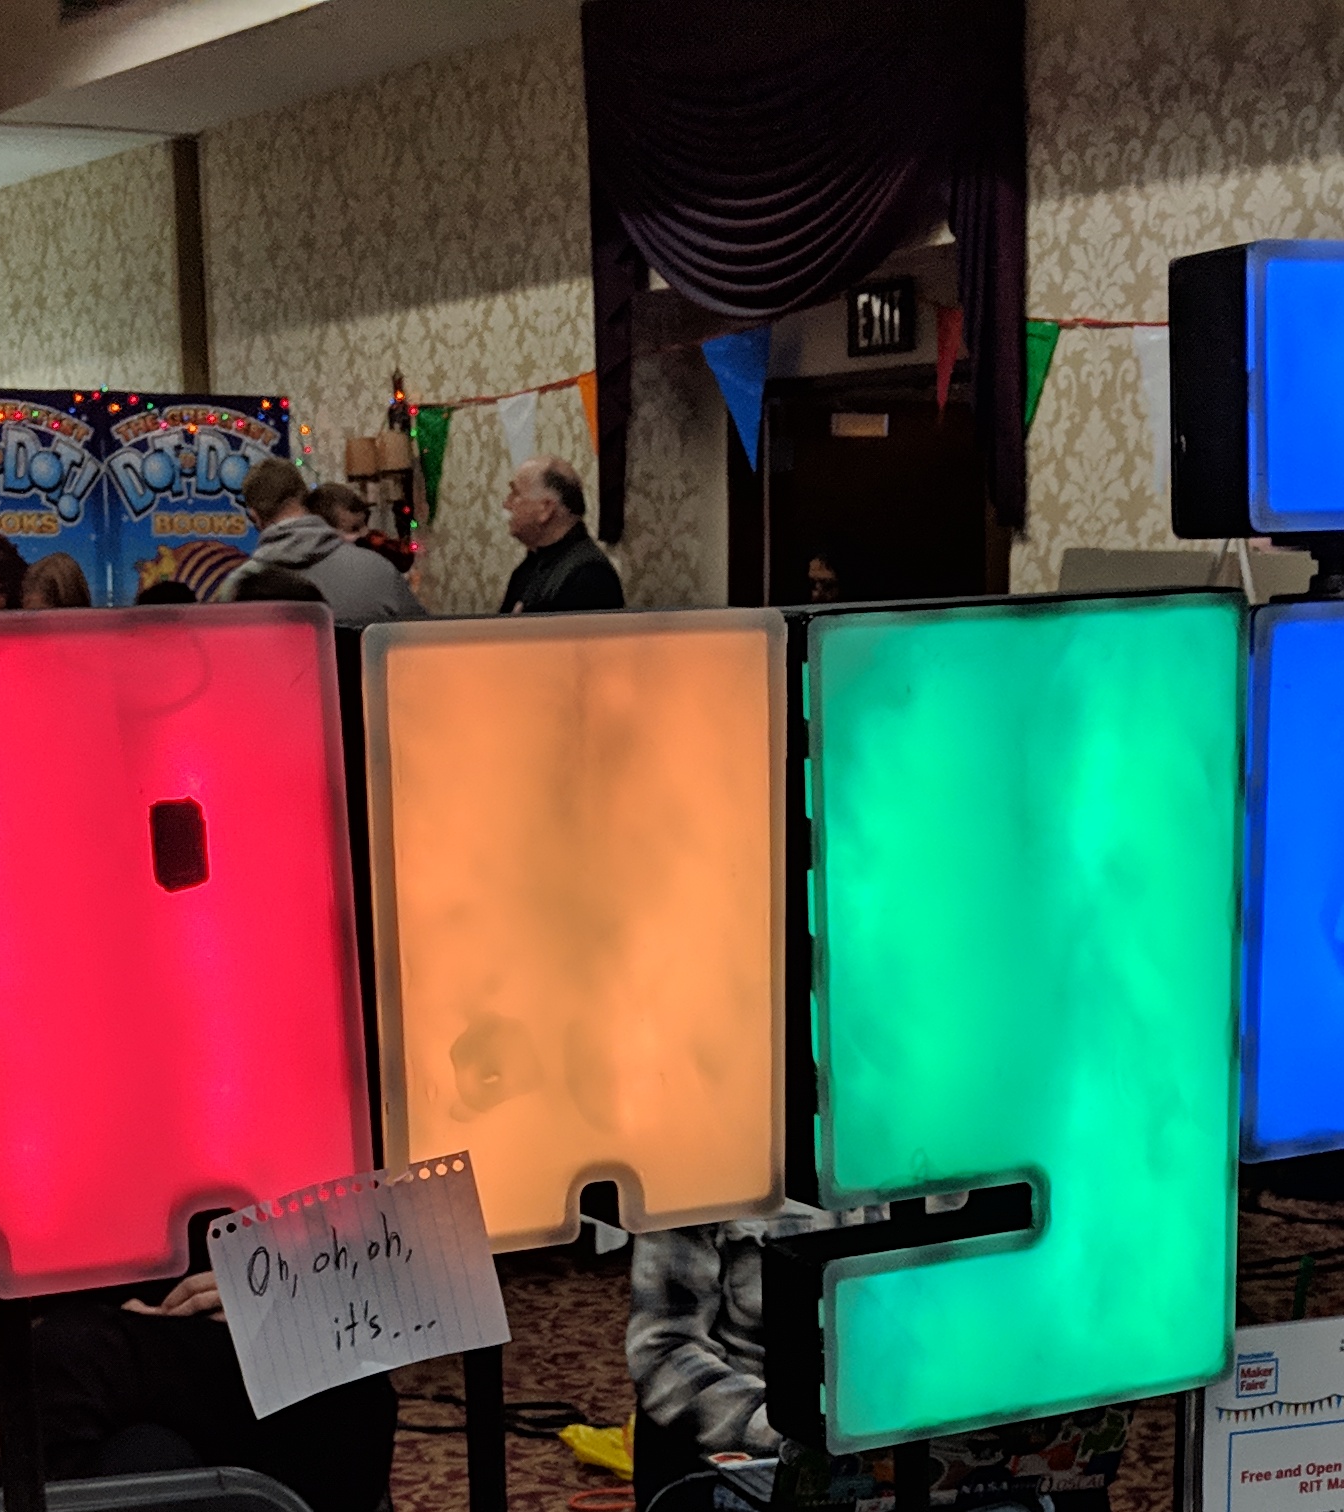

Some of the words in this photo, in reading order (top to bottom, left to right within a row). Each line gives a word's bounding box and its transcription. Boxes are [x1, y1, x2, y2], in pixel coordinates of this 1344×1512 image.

[155, 513, 247, 535] BOOKS
[1240, 1366, 1274, 1379] Maker
[1240, 1469, 1272, 1484] Free
[1275, 1464, 1302, 1480] and
[1305, 1462, 1342, 1479] Open
[1299, 1479, 1323, 1494] RIT
